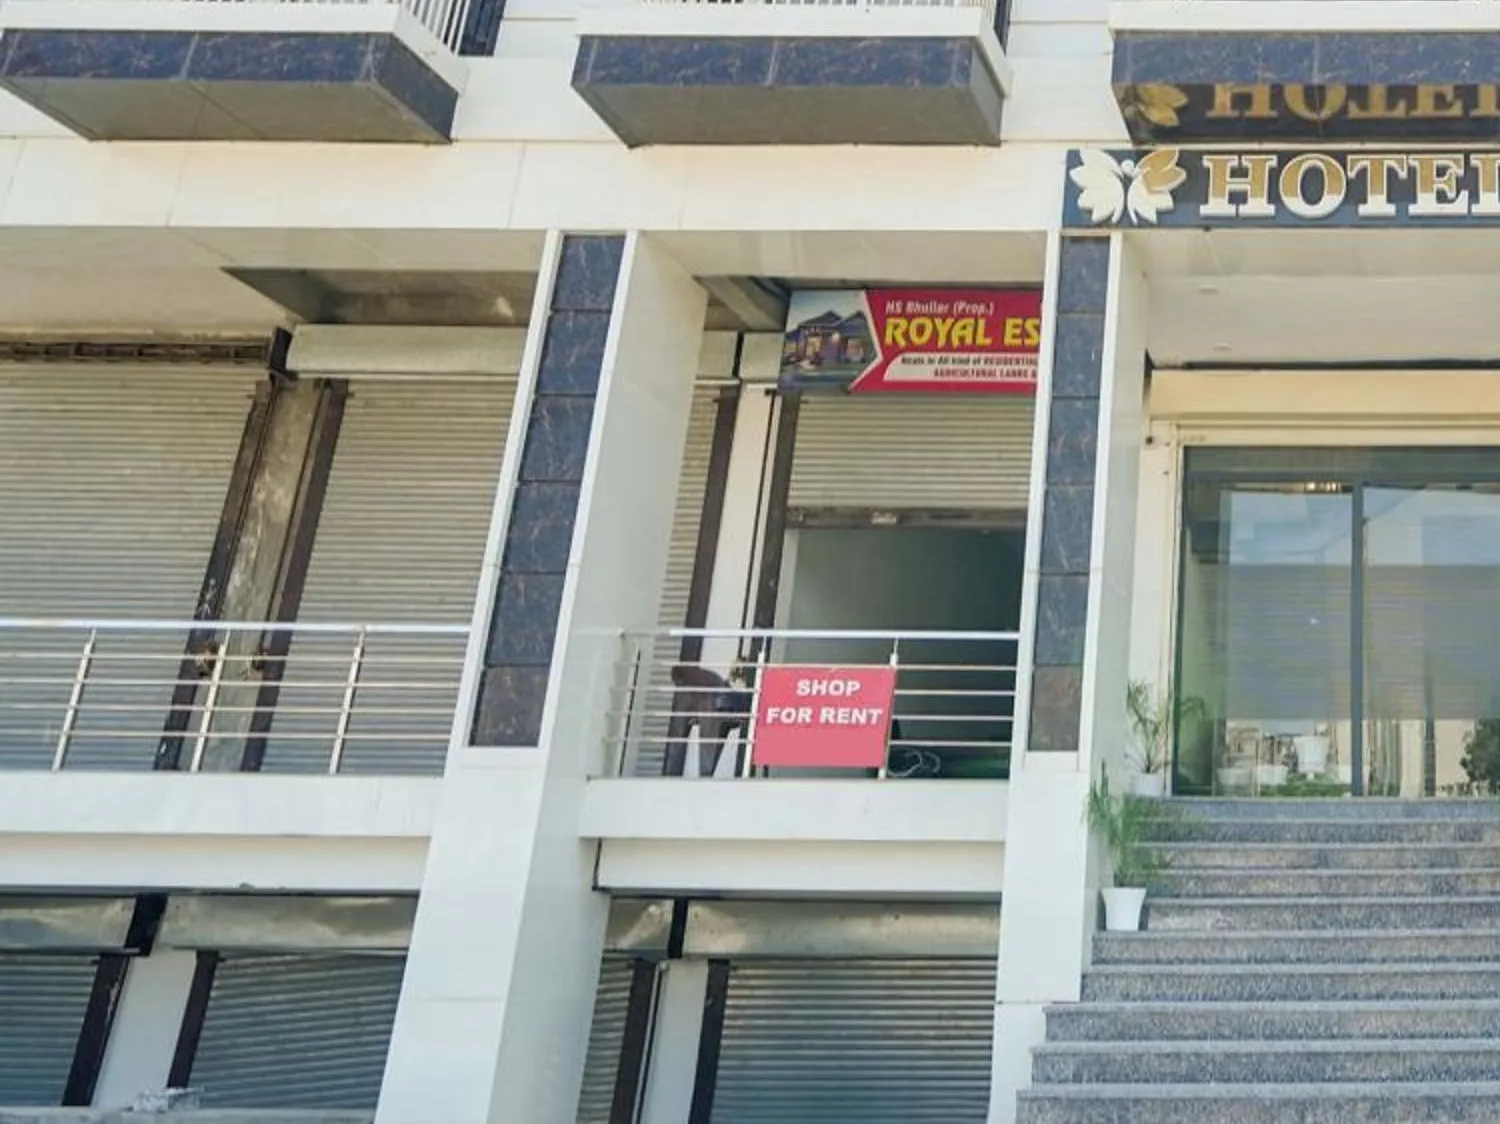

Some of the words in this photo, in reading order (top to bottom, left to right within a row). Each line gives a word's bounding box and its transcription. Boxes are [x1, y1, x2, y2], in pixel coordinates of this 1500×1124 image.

[884, 316, 993, 349] ROYAL
[796, 679, 861, 697] SHOP
[766, 707, 813, 725] FOR
[819, 707, 883, 725] RENT
